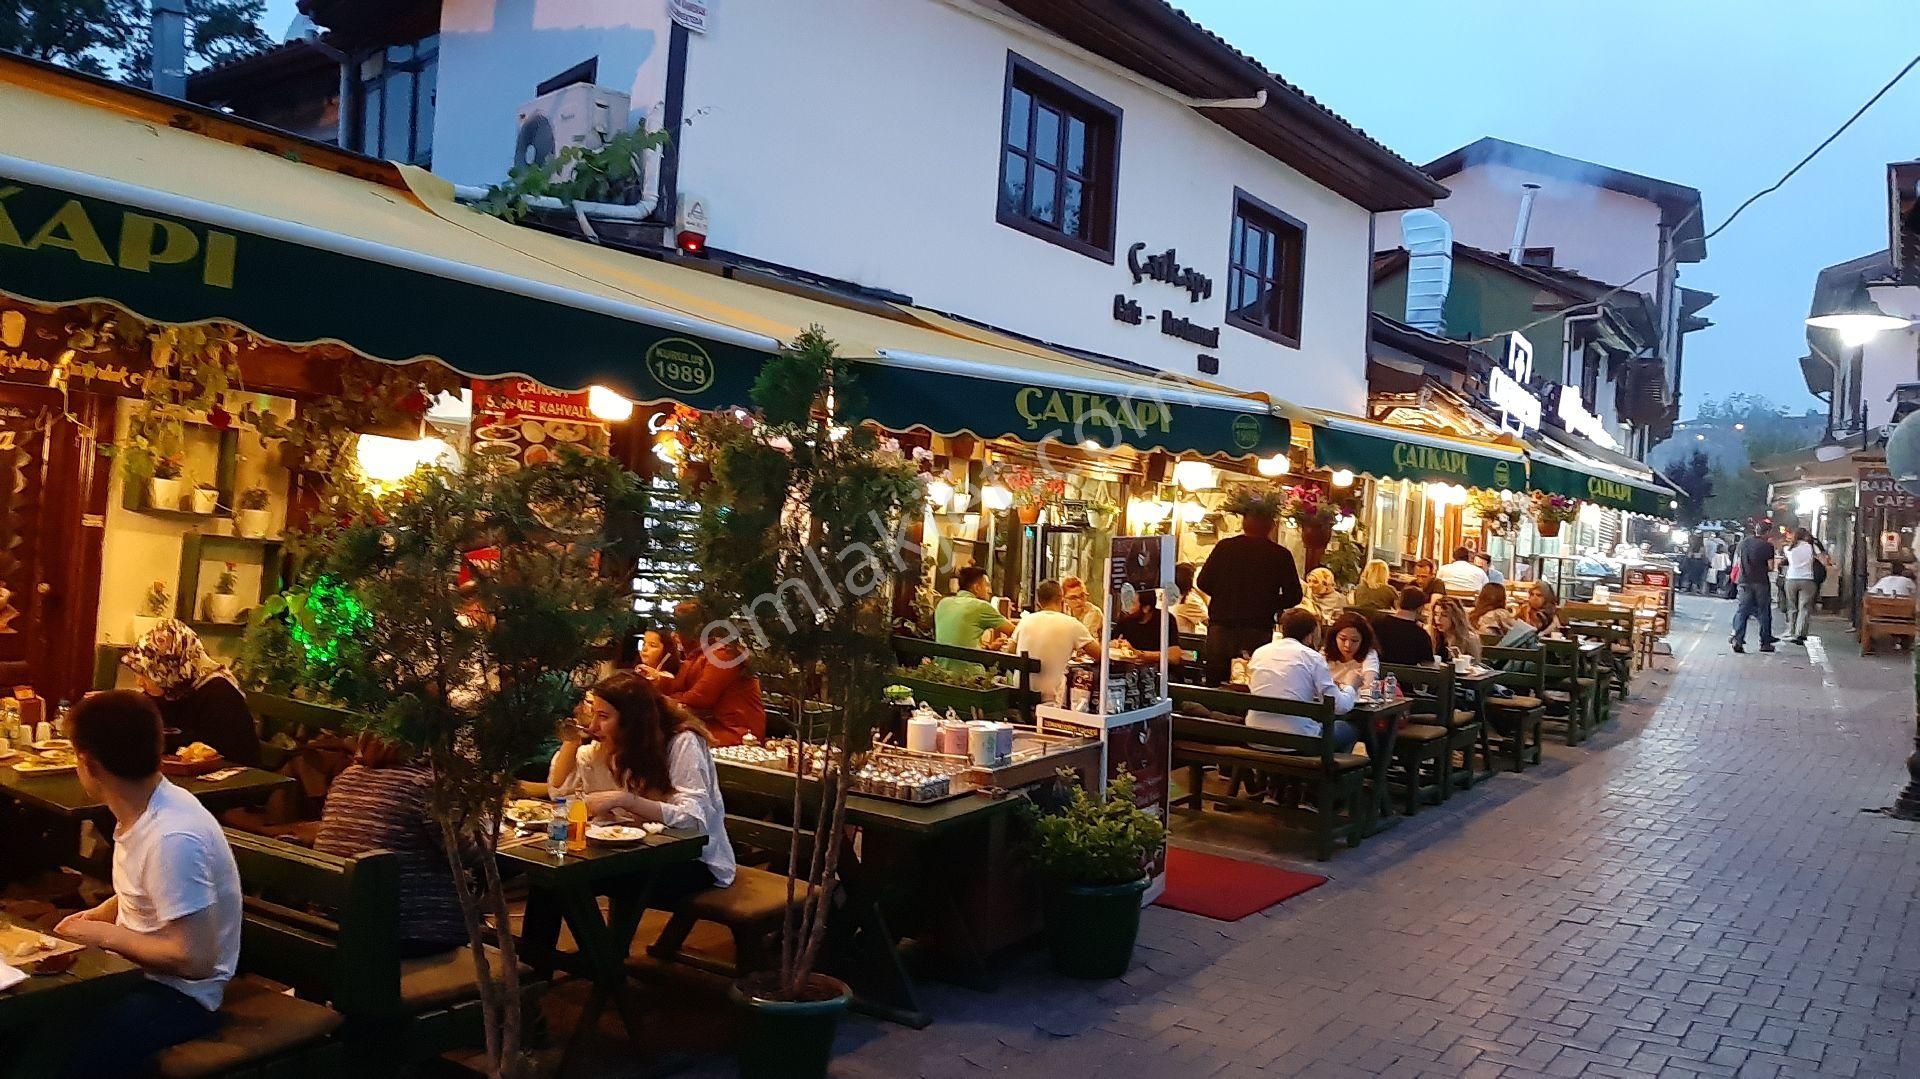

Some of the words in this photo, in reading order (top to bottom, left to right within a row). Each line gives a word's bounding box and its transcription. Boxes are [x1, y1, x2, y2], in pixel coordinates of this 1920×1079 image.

[0, 186, 237, 289] API
[655, 361, 706, 385] 1989
[1015, 387, 1172, 433] ÇATKAPI
[1874, 495, 1914, 507] CAFE
